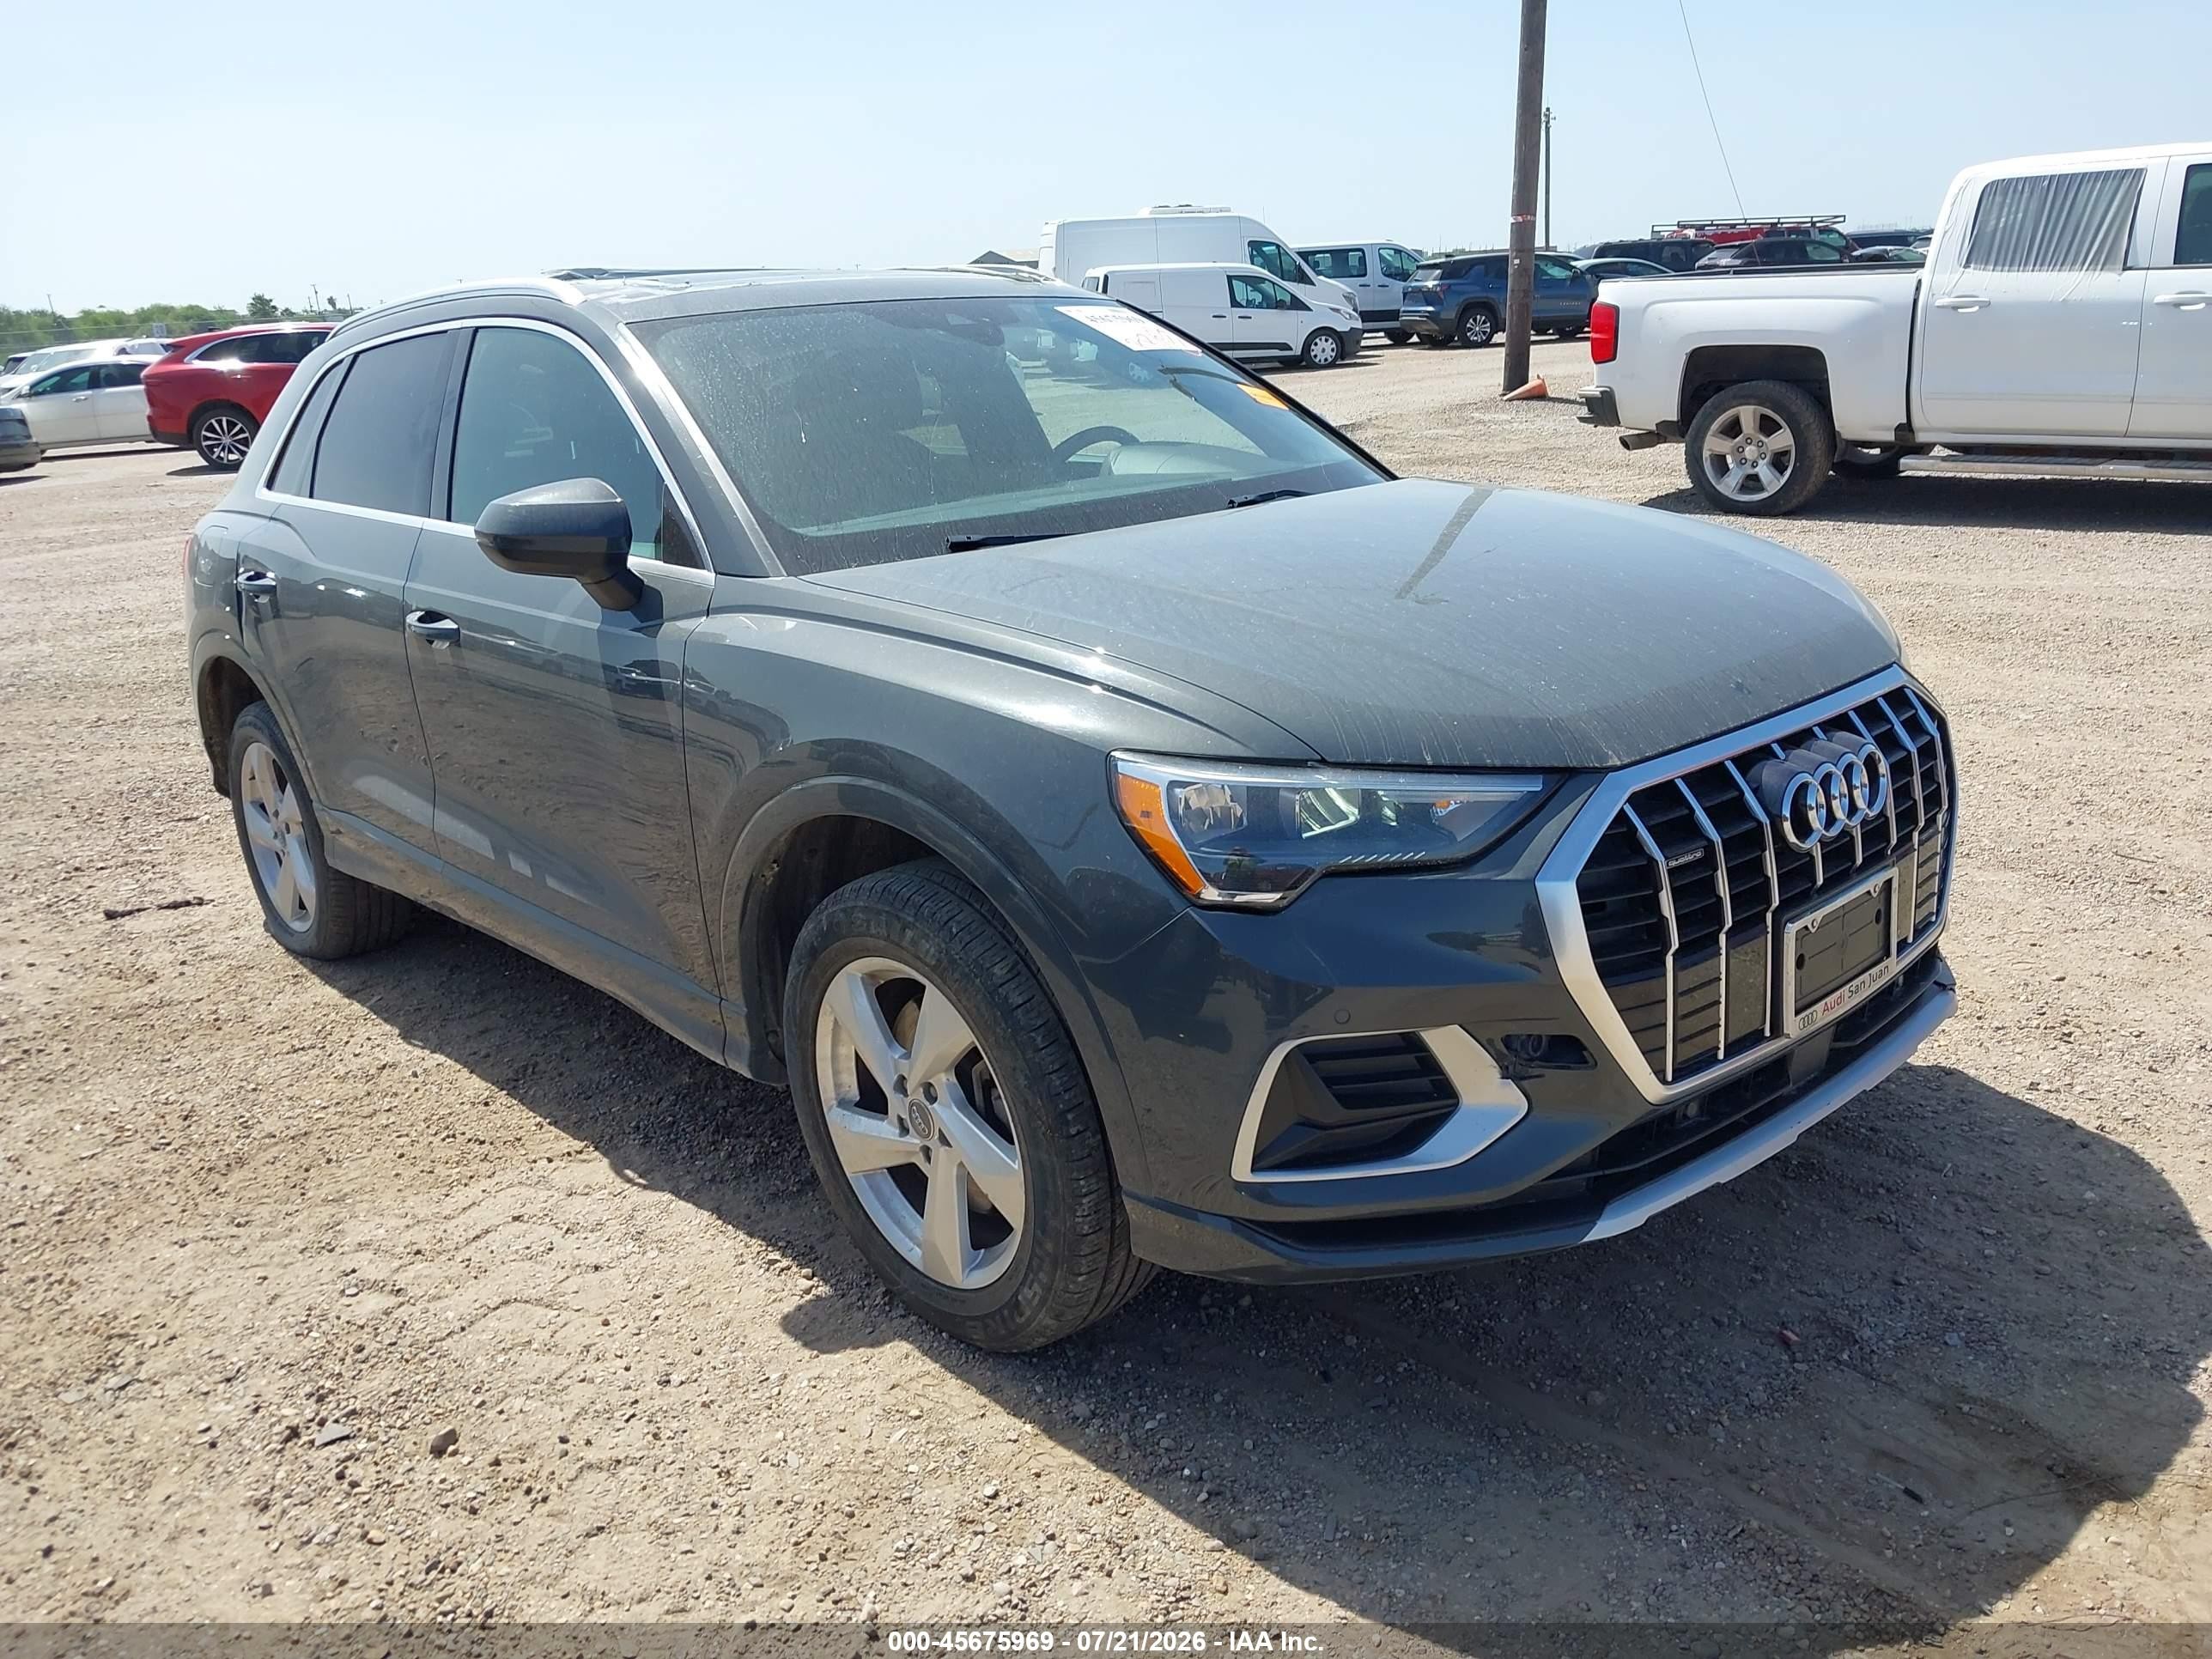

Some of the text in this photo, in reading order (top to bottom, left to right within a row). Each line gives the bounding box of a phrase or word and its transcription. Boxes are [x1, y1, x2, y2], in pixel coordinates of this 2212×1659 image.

[1668, 851, 1702, 866] quattro
[1821, 964, 1889, 1016] Audi San Juan
